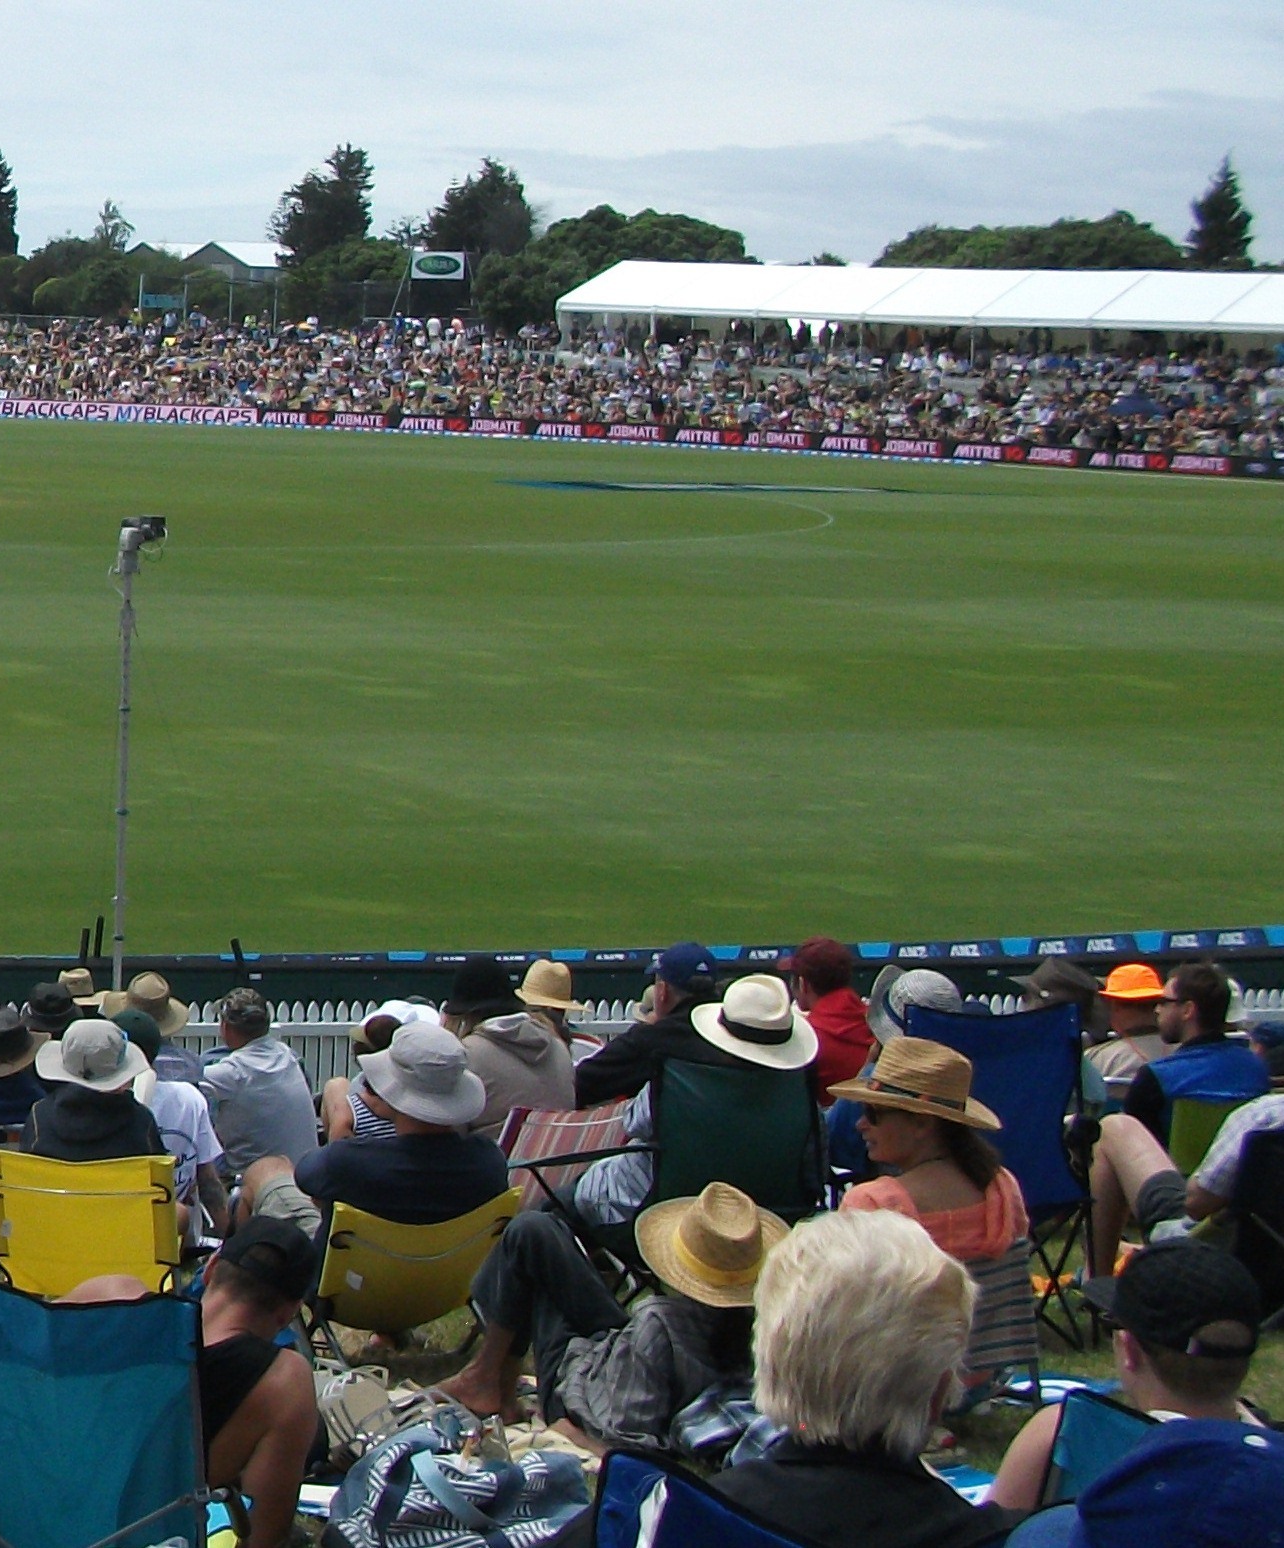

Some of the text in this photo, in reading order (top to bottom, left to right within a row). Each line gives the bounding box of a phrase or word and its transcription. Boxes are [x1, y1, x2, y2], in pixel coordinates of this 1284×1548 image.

[116, 406, 252, 424] MYBLACKCAPS
[262, 411, 307, 426] MITRE
[330, 413, 384, 428] JOBMATE
[399, 417, 445, 432] MITRE
[468, 420, 522, 434] JOBMATE
[536, 423, 583, 438] MITRE
[606, 426, 659, 440] JOBMATE
[675, 429, 721, 444] MITRE
[821, 437, 869, 452] MITRE
[953, 444, 1002, 460] MITRE
[898, 945, 928, 958] ANZ
[950, 943, 980, 958] ANZ
